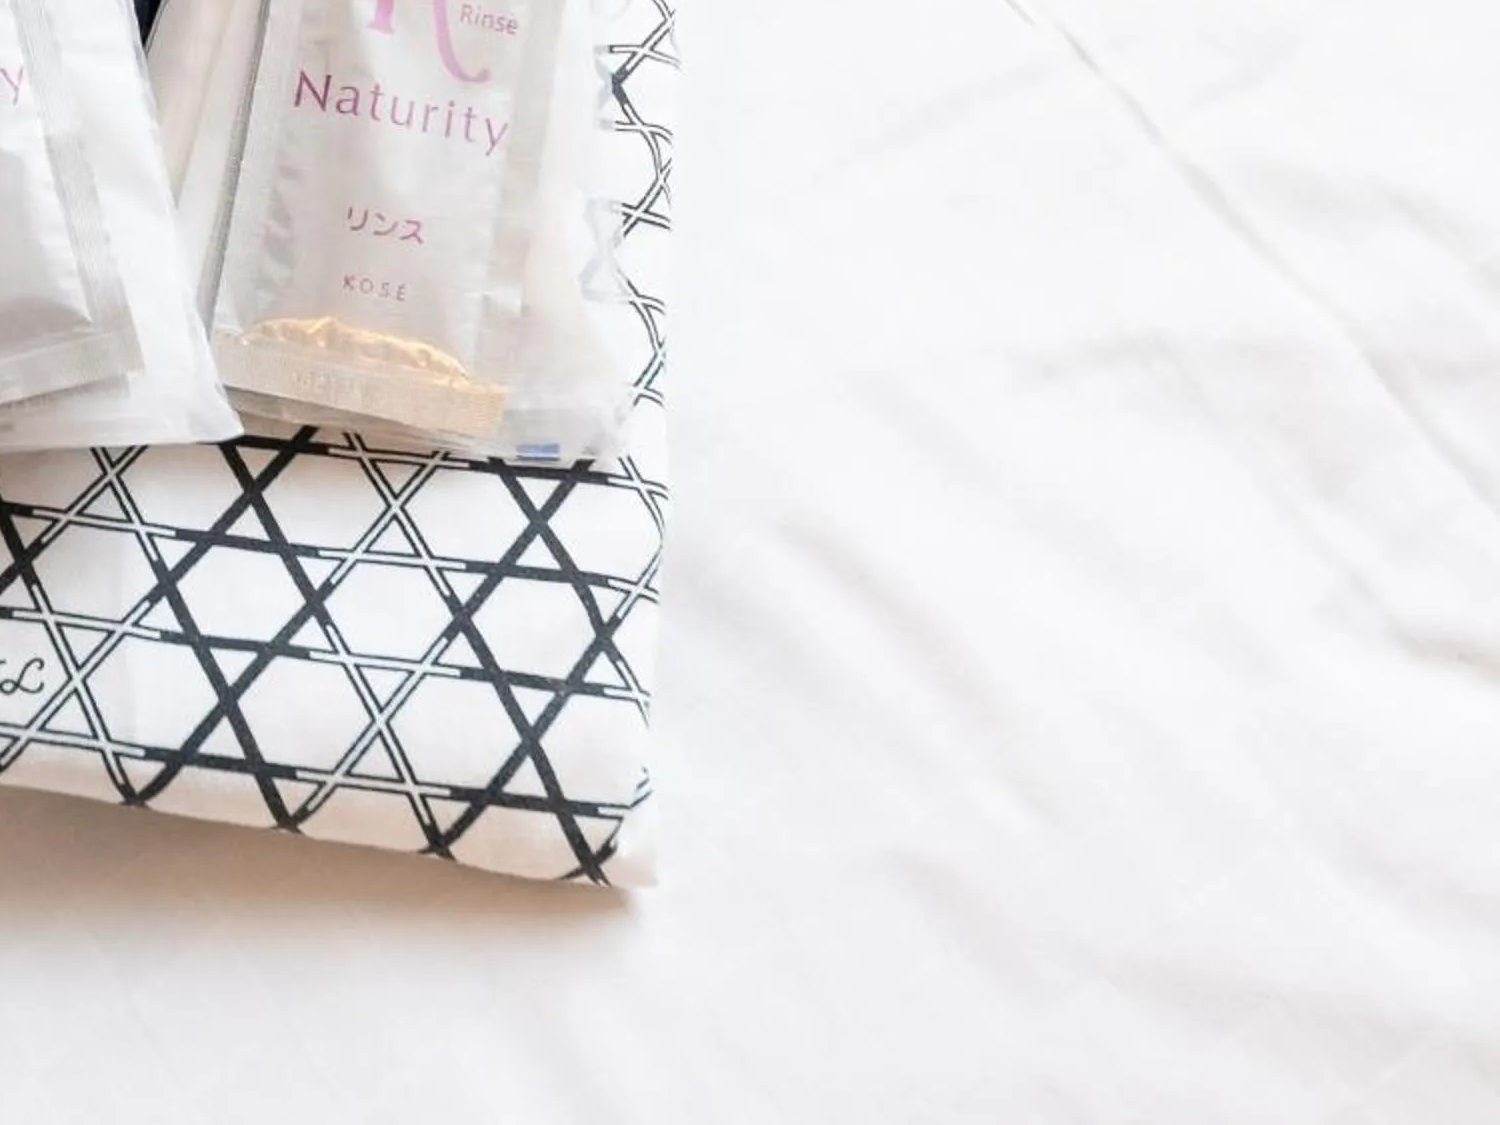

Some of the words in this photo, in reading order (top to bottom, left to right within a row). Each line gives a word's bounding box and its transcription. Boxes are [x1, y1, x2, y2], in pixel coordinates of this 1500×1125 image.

[460, 3, 519, 35] Rinse
[293, 70, 509, 157] Naturity
[347, 206, 425, 245] リンス
